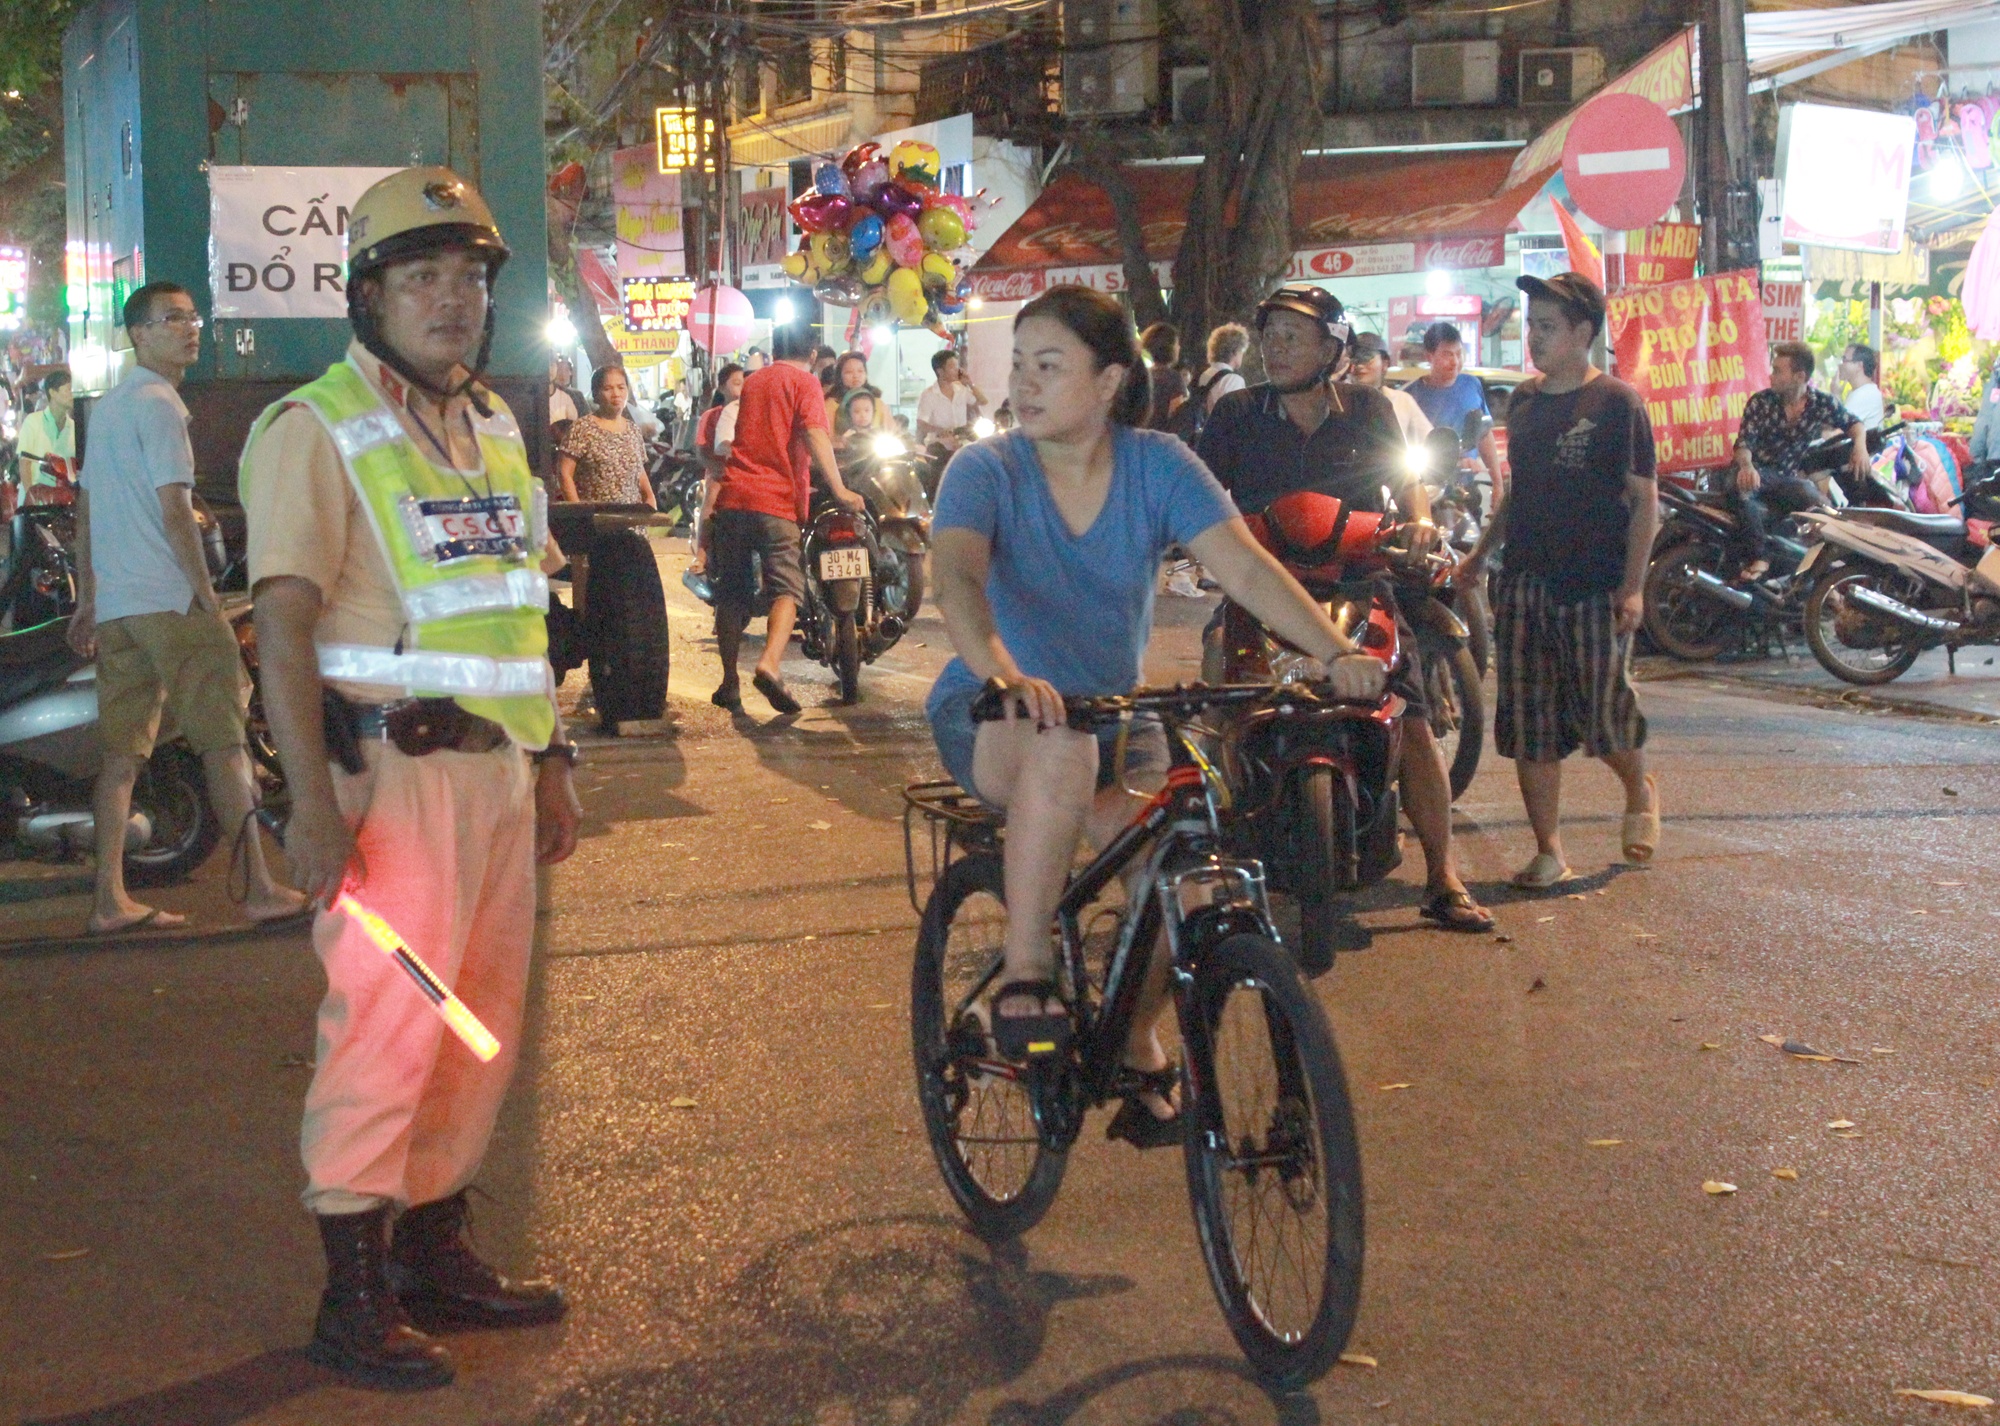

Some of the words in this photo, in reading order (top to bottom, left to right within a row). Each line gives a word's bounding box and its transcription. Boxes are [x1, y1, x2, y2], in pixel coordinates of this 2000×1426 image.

[1650, 225, 1699, 258] CARD
[225, 245, 296, 292] ĐỔ
[1323, 253, 1342, 272] 46
[1638, 262, 1665, 281] OLD
[1105, 271, 1128, 290] S
[1715, 276, 1756, 304] TA
[1764, 283, 1803, 307] SIM
[1641, 314, 1697, 353] PHỞ
[1650, 359, 1687, 389] BÚN
[1688, 355, 1745, 385] THANG
[1671, 393, 1723, 425] MĂNG
[827, 564, 861, 578] 5348
